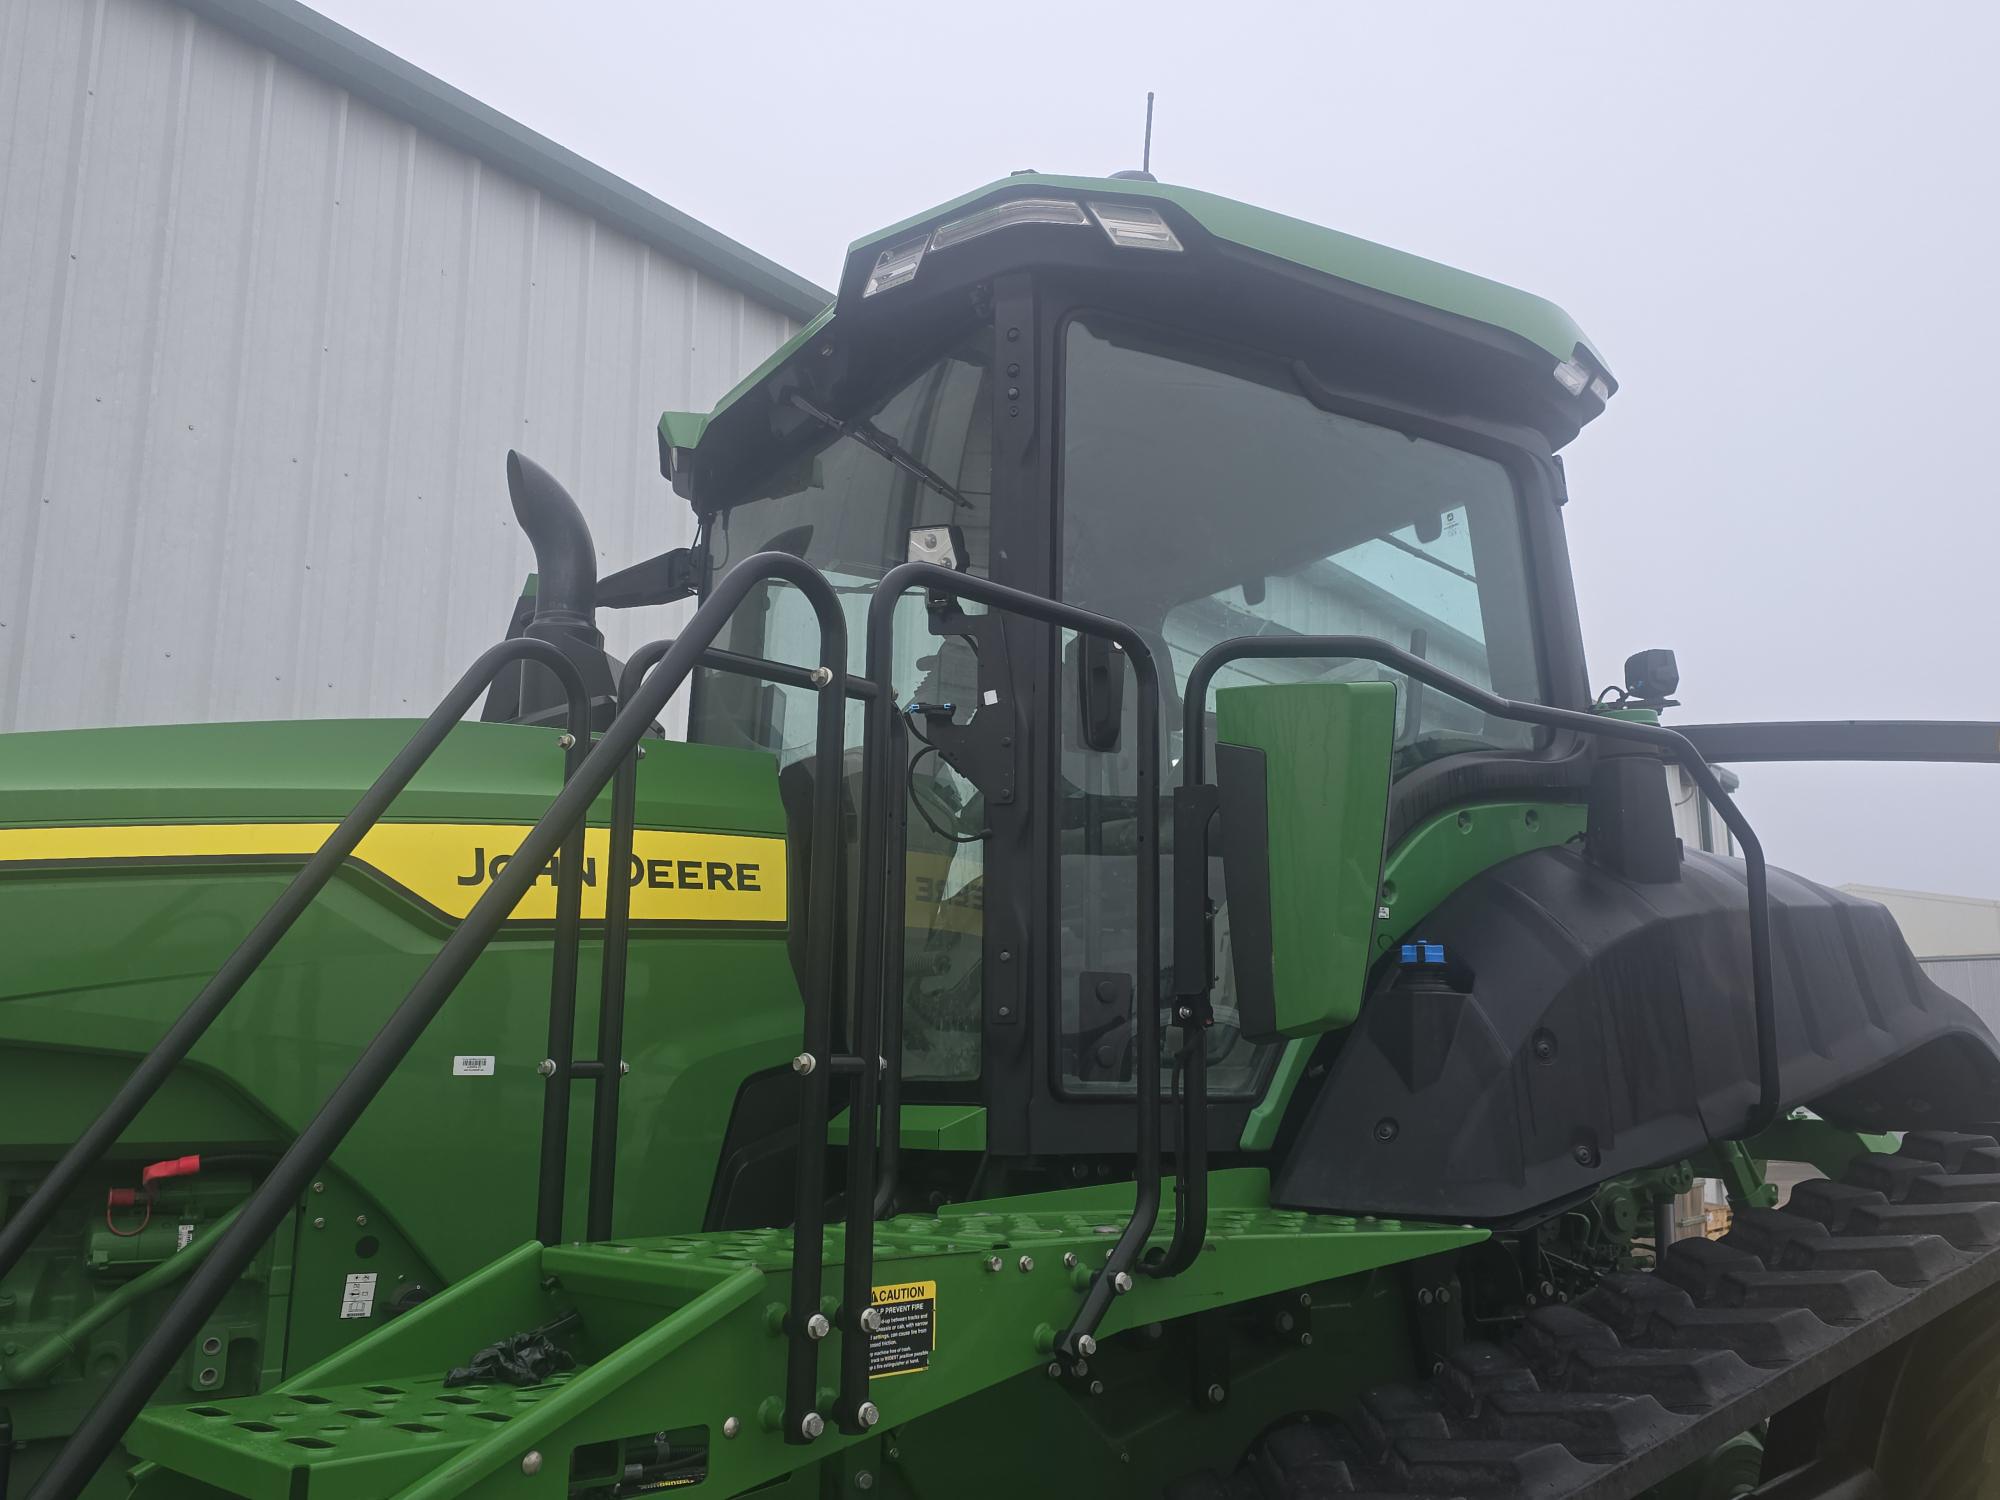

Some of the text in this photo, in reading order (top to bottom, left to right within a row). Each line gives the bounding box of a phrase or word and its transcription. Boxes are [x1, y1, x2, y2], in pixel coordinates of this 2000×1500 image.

[879, 1286, 925, 1302] CAUTION
[885, 1305, 910, 1314] PREVENT
[912, 1303, 924, 1311] FIRE
